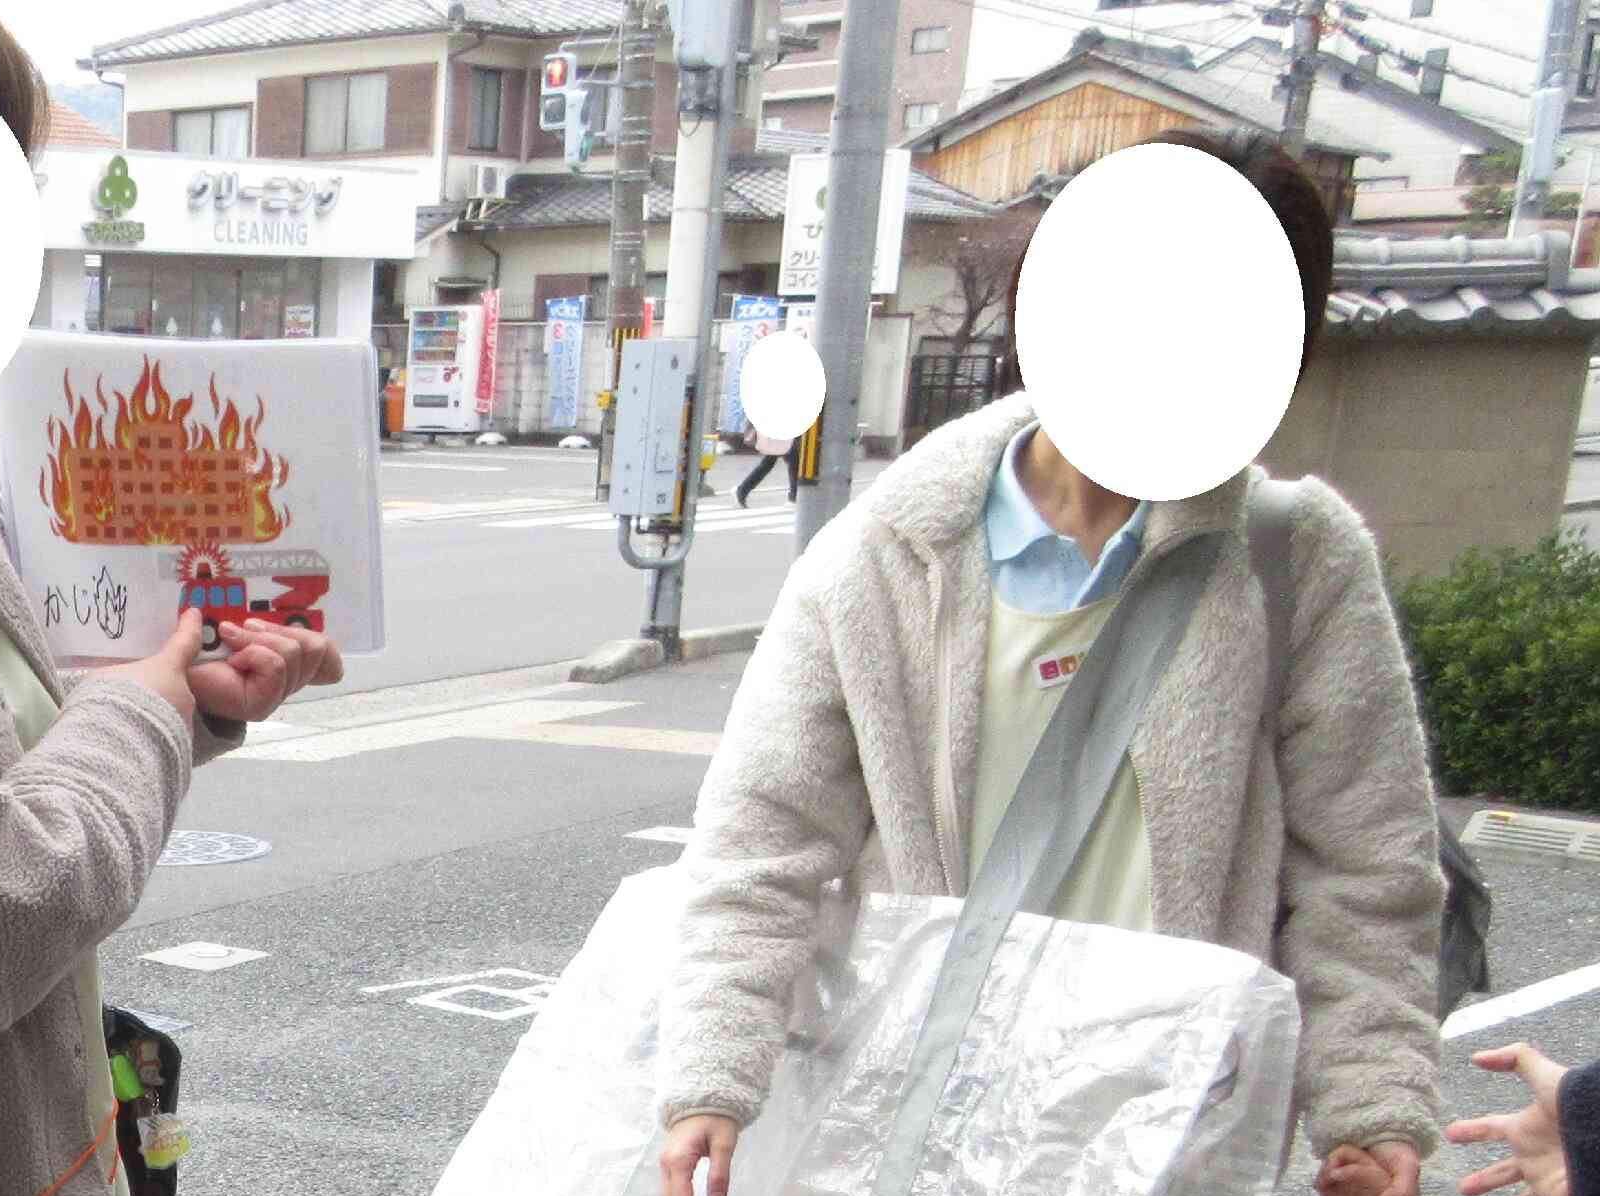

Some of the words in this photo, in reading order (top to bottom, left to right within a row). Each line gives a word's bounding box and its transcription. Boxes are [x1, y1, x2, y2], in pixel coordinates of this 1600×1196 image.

[187, 170, 343, 216] クリーニング
[213, 219, 309, 246] CLEANING
[43, 583, 91, 628] かじ
